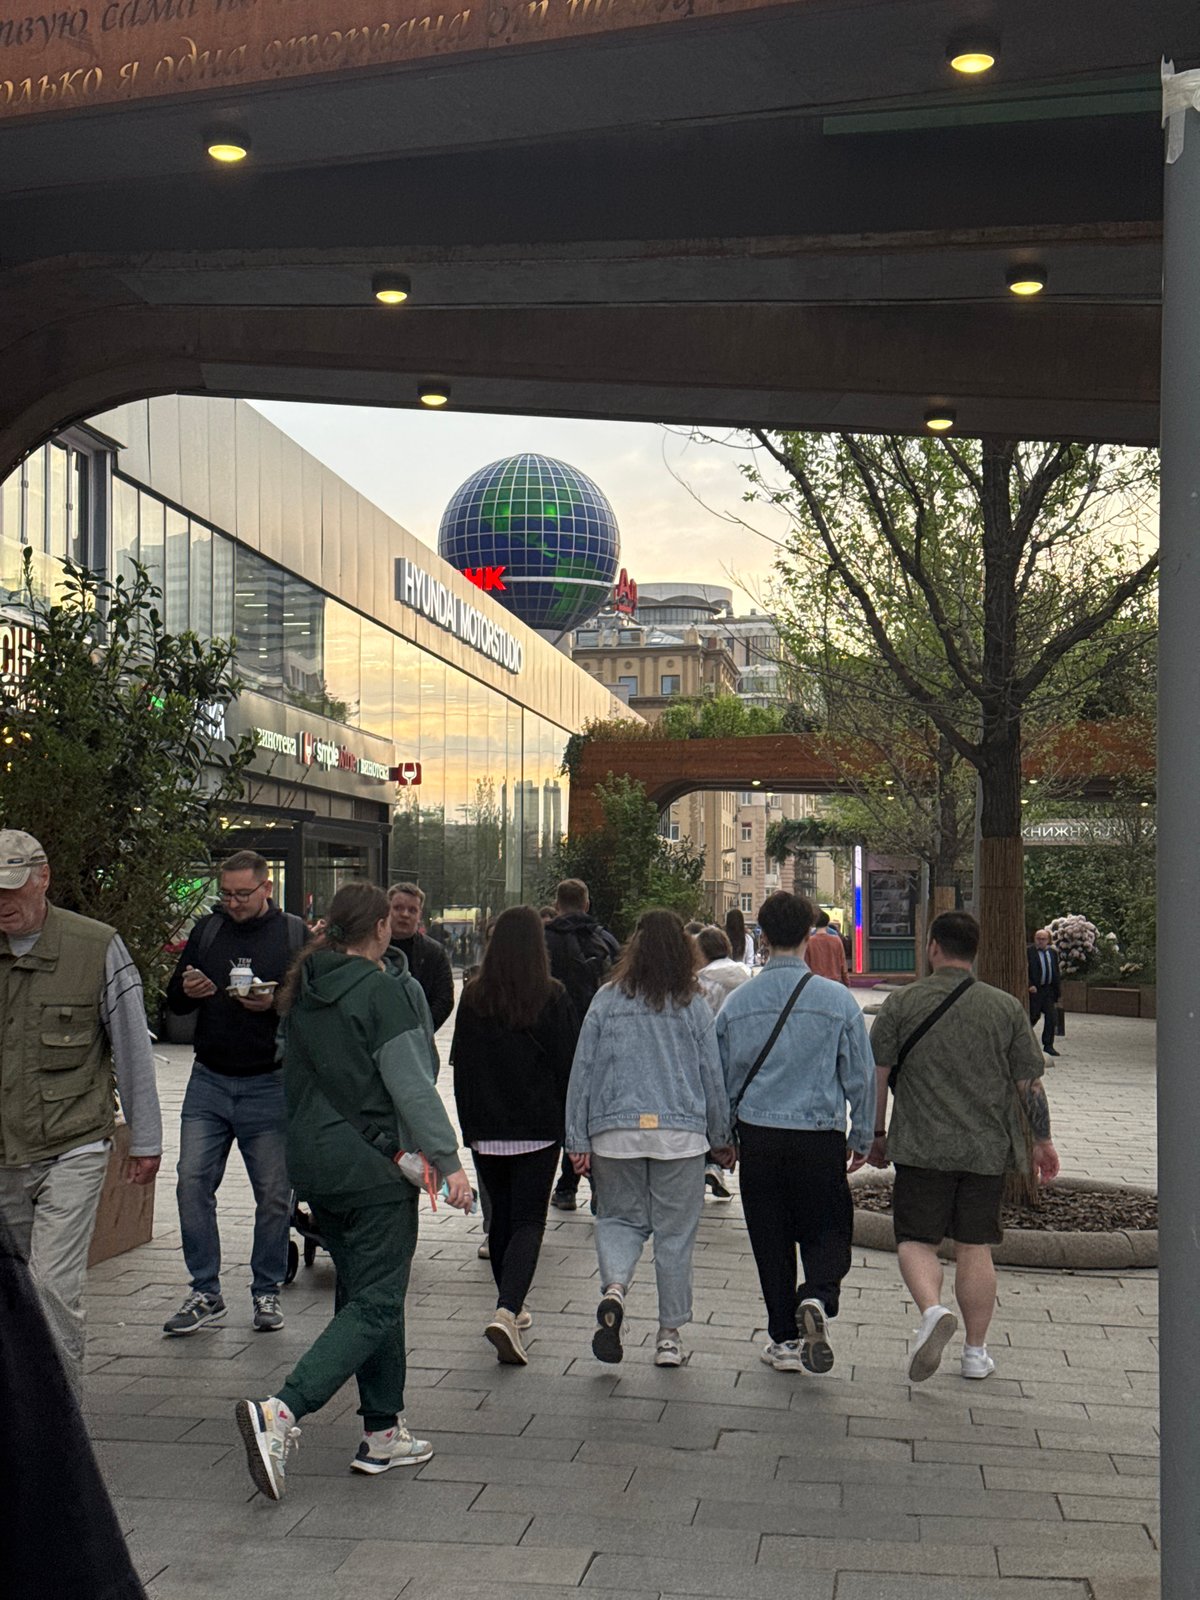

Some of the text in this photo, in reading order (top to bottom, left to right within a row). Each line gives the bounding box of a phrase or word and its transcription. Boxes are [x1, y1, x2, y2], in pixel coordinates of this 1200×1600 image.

[115, 61, 140, 92] я
[153, 36, 248, 84] одна
[262, 9, 472, 70] оторвана
[404, 558, 524, 675] HYUNDAI MOTORSTUDIO
